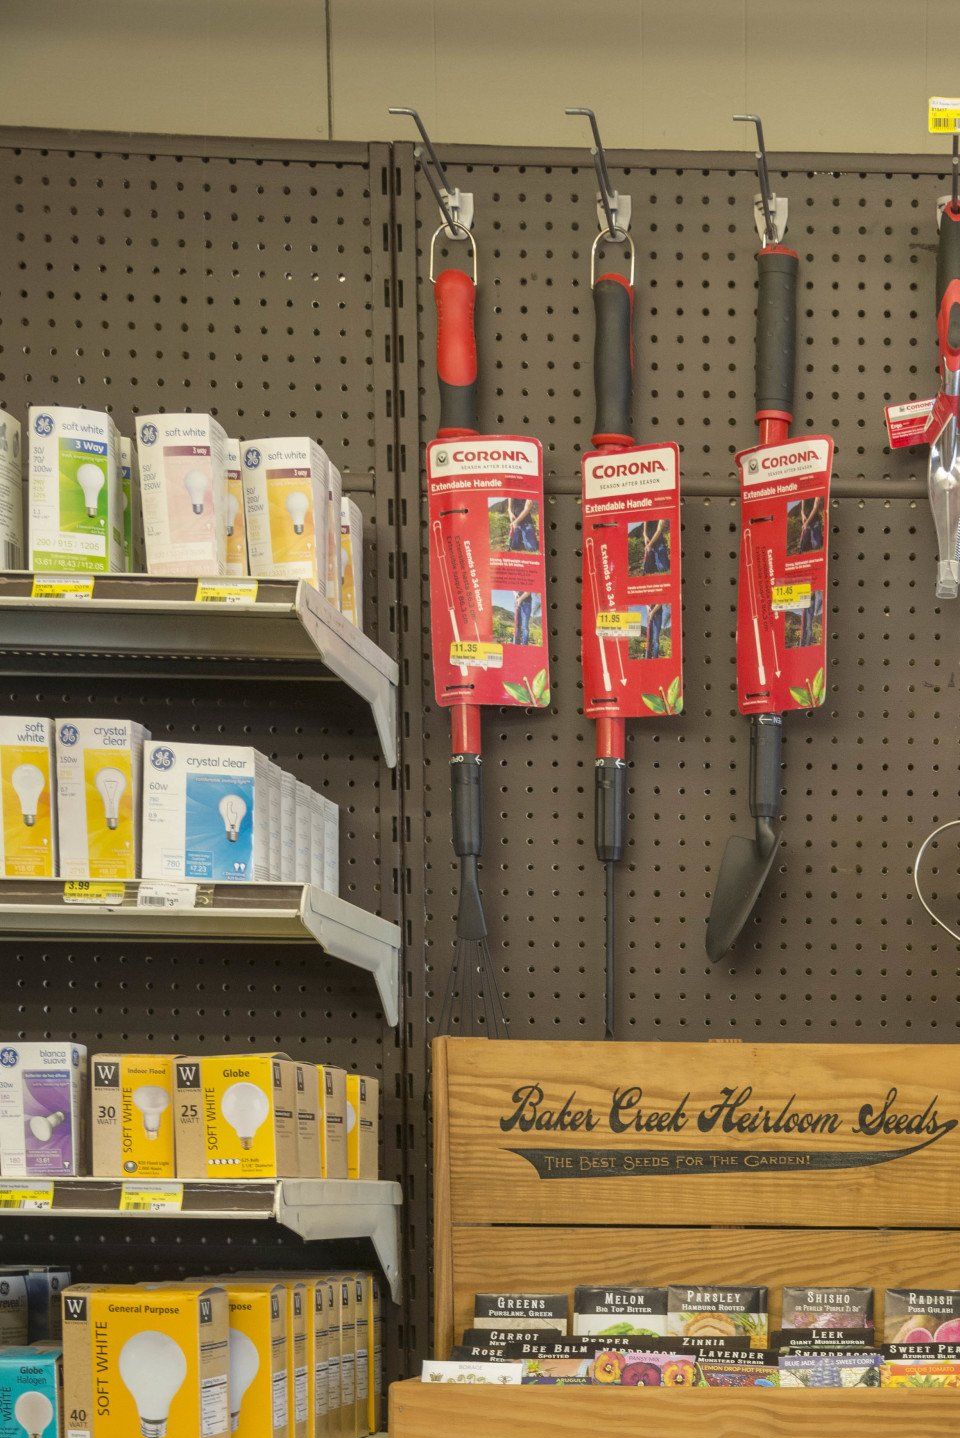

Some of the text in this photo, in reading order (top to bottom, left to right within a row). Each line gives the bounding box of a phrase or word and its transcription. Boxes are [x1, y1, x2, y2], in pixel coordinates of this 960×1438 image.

[62, 424, 104, 434] soft white
[165, 428, 205, 437] soft white
[76, 440, 104, 454] 3 Way
[452, 450, 532, 464] CORONA
[592, 461, 667, 479] CORONA
[431, 479, 502, 492] Extendable Handle
[464, 541, 484, 612] Extends to 34 inches
[600, 615, 620, 623] 11.95
[455, 644, 477, 652] 11.35
[25, 723, 44, 732] soft
[94, 727, 126, 738] crystal
[17, 733, 45, 743] white
[103, 736, 126, 746] clear
[187, 757, 247, 770] crystal clear
[150, 782, 168, 791] 60w
[68, 882, 90, 890] 3.99
[40, 1050, 66, 1058] blanca
[43, 1057, 66, 1065] suave
[127, 1067, 166, 1075] Indoor Flood
[223, 1068, 250, 1078] Globe
[98, 1106, 116, 1118] 30
[181, 1105, 198, 1117] 25
[500, 1083, 940, 1136] Baker Creek Heirloom Seeds
[122, 1087, 133, 1153] SOFT WHITE
[545, 1154, 811, 1170] THE BEST SEEDS FOR THE GARDEN!
[605, 1293, 644, 1305] MELON
[687, 1291, 740, 1303] PARSLEY
[807, 1292, 850, 1303] SHISHO
[909, 1293, 953, 1304] RADISH
[498, 1297, 545, 1309] GREENS
[108, 1304, 180, 1317] General Purpose
[491, 1331, 539, 1341] CARROT
[812, 1330, 844, 1338] LEEK
[682, 1338, 725, 1346] ZINNIA
[472, 1348, 504, 1356] ROSE
[523, 1344, 587, 1353] BEE BALM
[890, 1345, 931, 1353] SWEET
[699, 1349, 764, 1359] LAVENDER
[20, 1367, 43, 1375] Globe
[95, 1321, 110, 1416] SOFT WHITE
[16, 1376, 47, 1386] Halogen
[70, 1410, 86, 1421] 40
